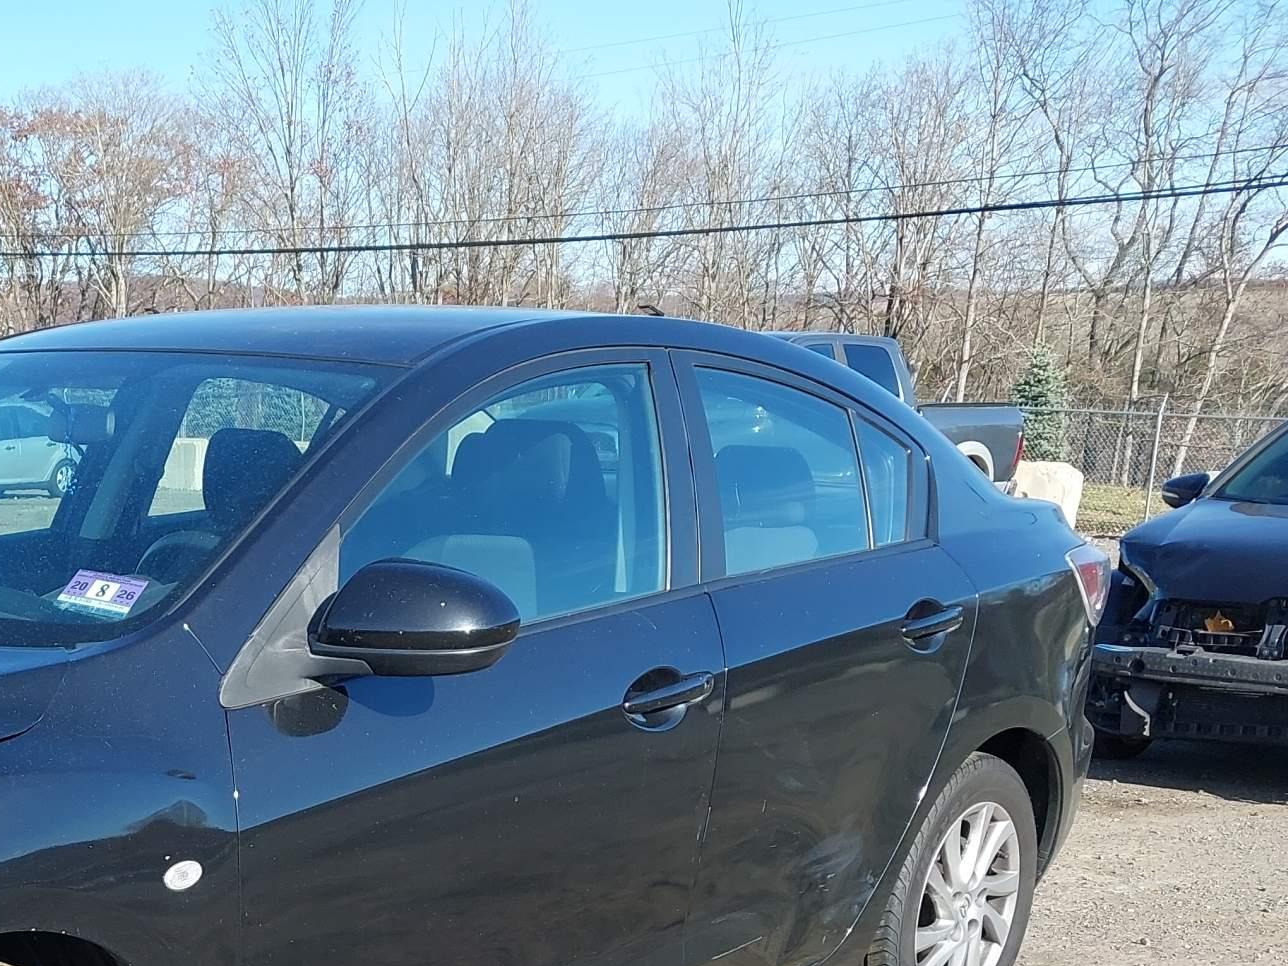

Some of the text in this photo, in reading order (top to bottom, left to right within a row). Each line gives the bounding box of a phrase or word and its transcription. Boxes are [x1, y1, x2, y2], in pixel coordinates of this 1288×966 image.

[70, 580, 89, 591] 20
[95, 584, 110, 597] 8
[116, 590, 136, 601] 26
